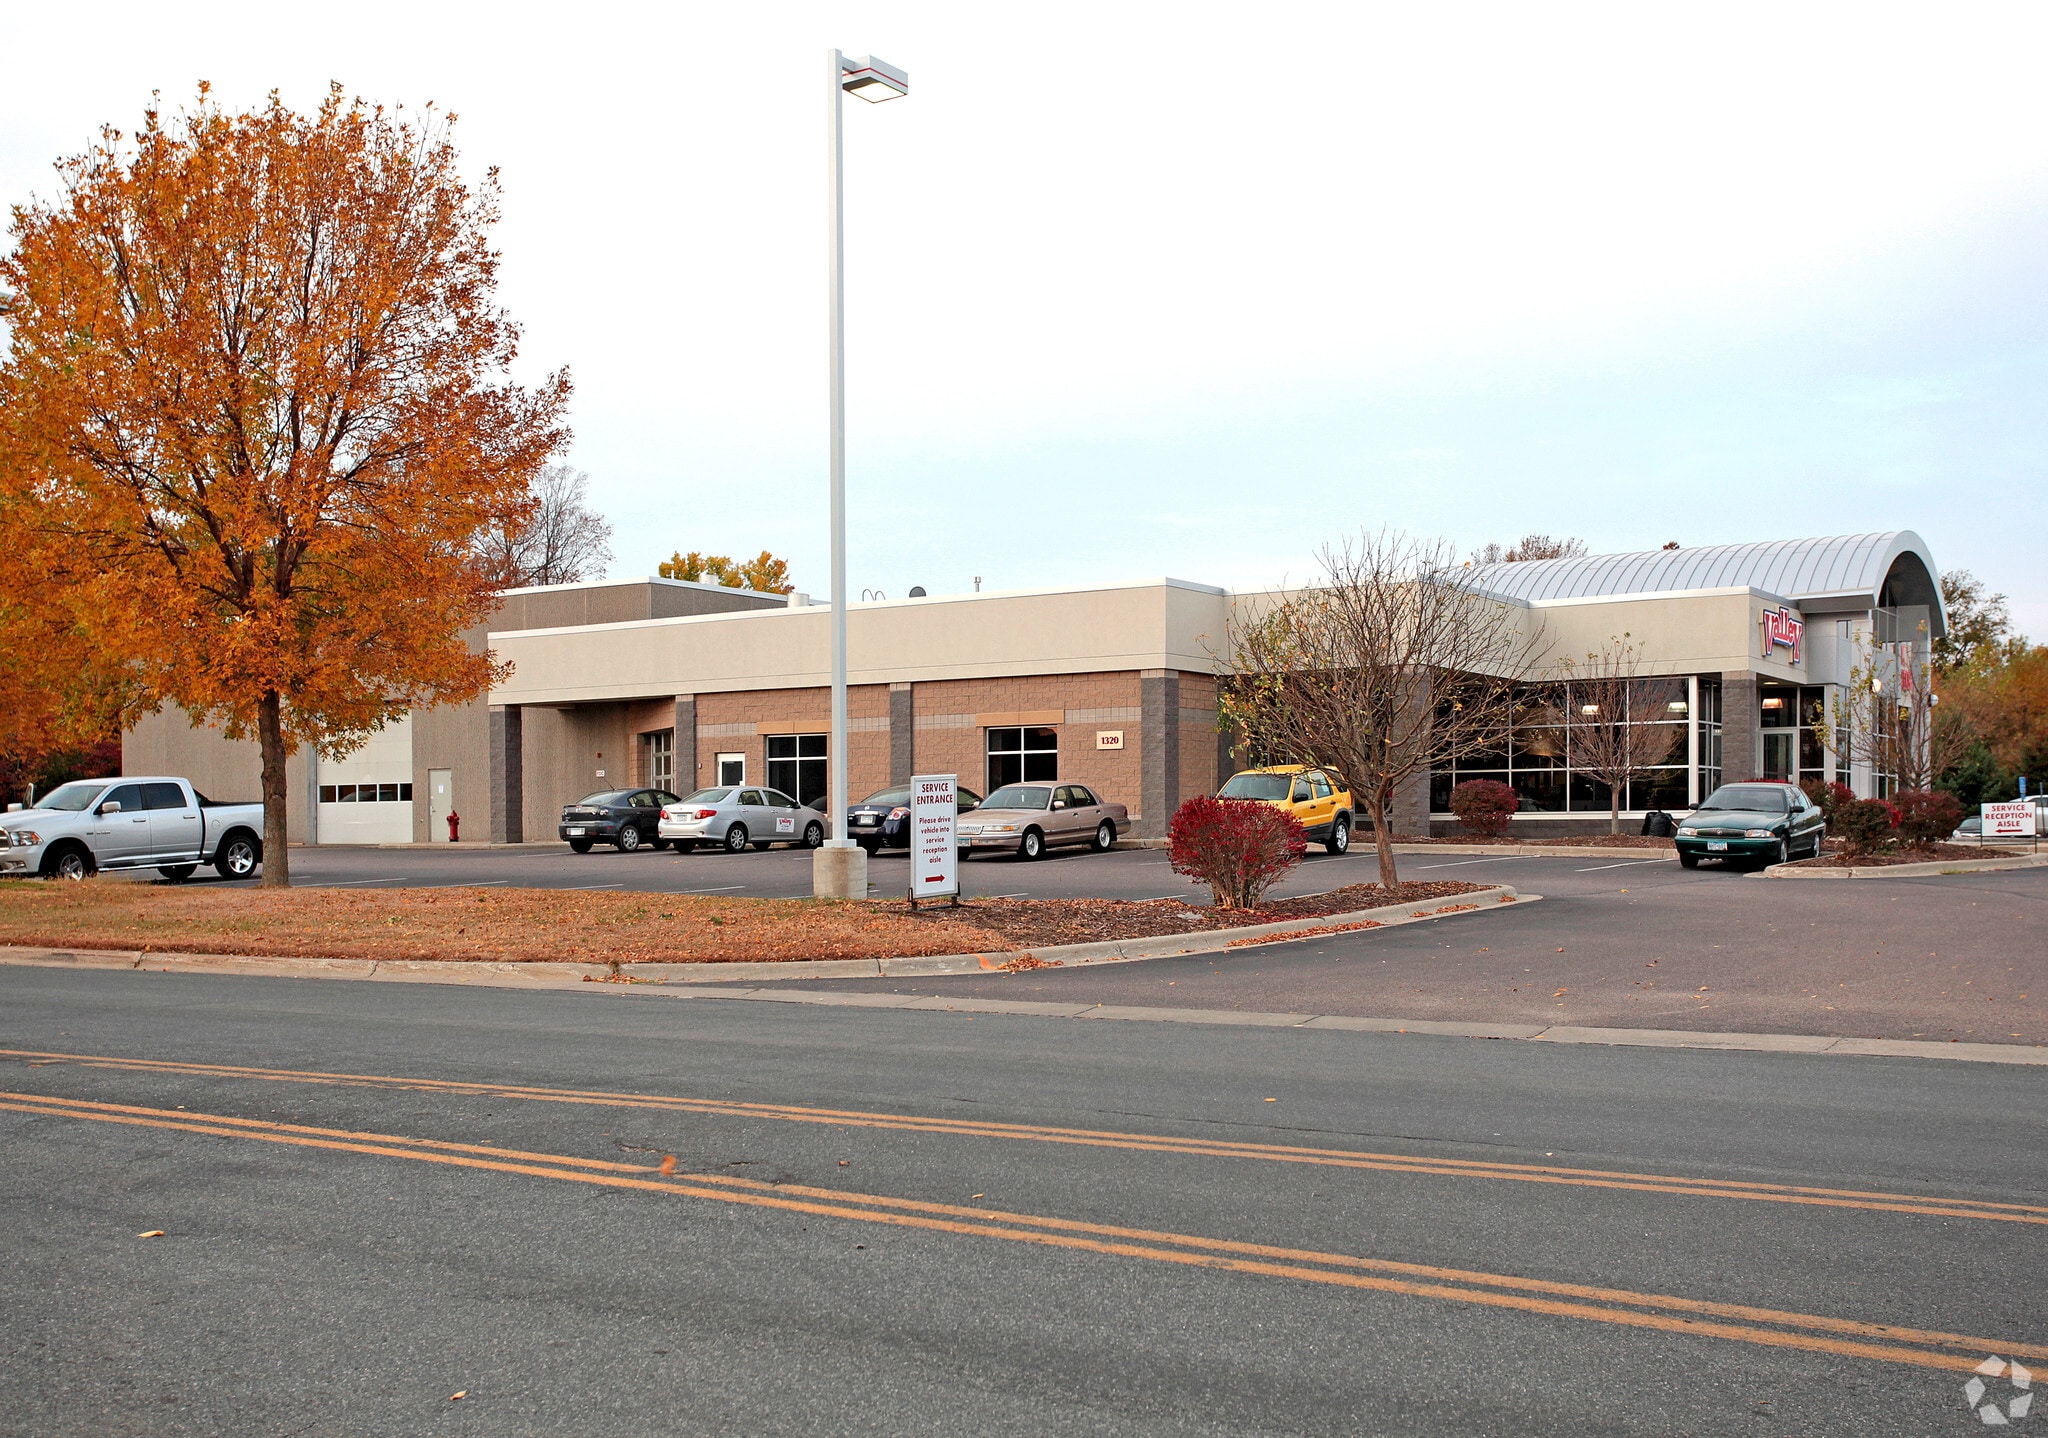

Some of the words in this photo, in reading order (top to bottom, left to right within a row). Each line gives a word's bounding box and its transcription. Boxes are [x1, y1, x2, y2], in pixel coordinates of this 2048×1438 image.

[1101, 736, 1119, 745] 1320
[921, 782, 949, 793] SERVICE
[916, 794, 953, 805] ENTRANCE
[1991, 804, 2025, 812] SERVICE
[1984, 812, 2032, 820] RECEPTION
[939, 825, 950, 833] into
[925, 836, 945, 844] service
[922, 846, 948, 855] reception
[929, 856, 942, 864] aisle
